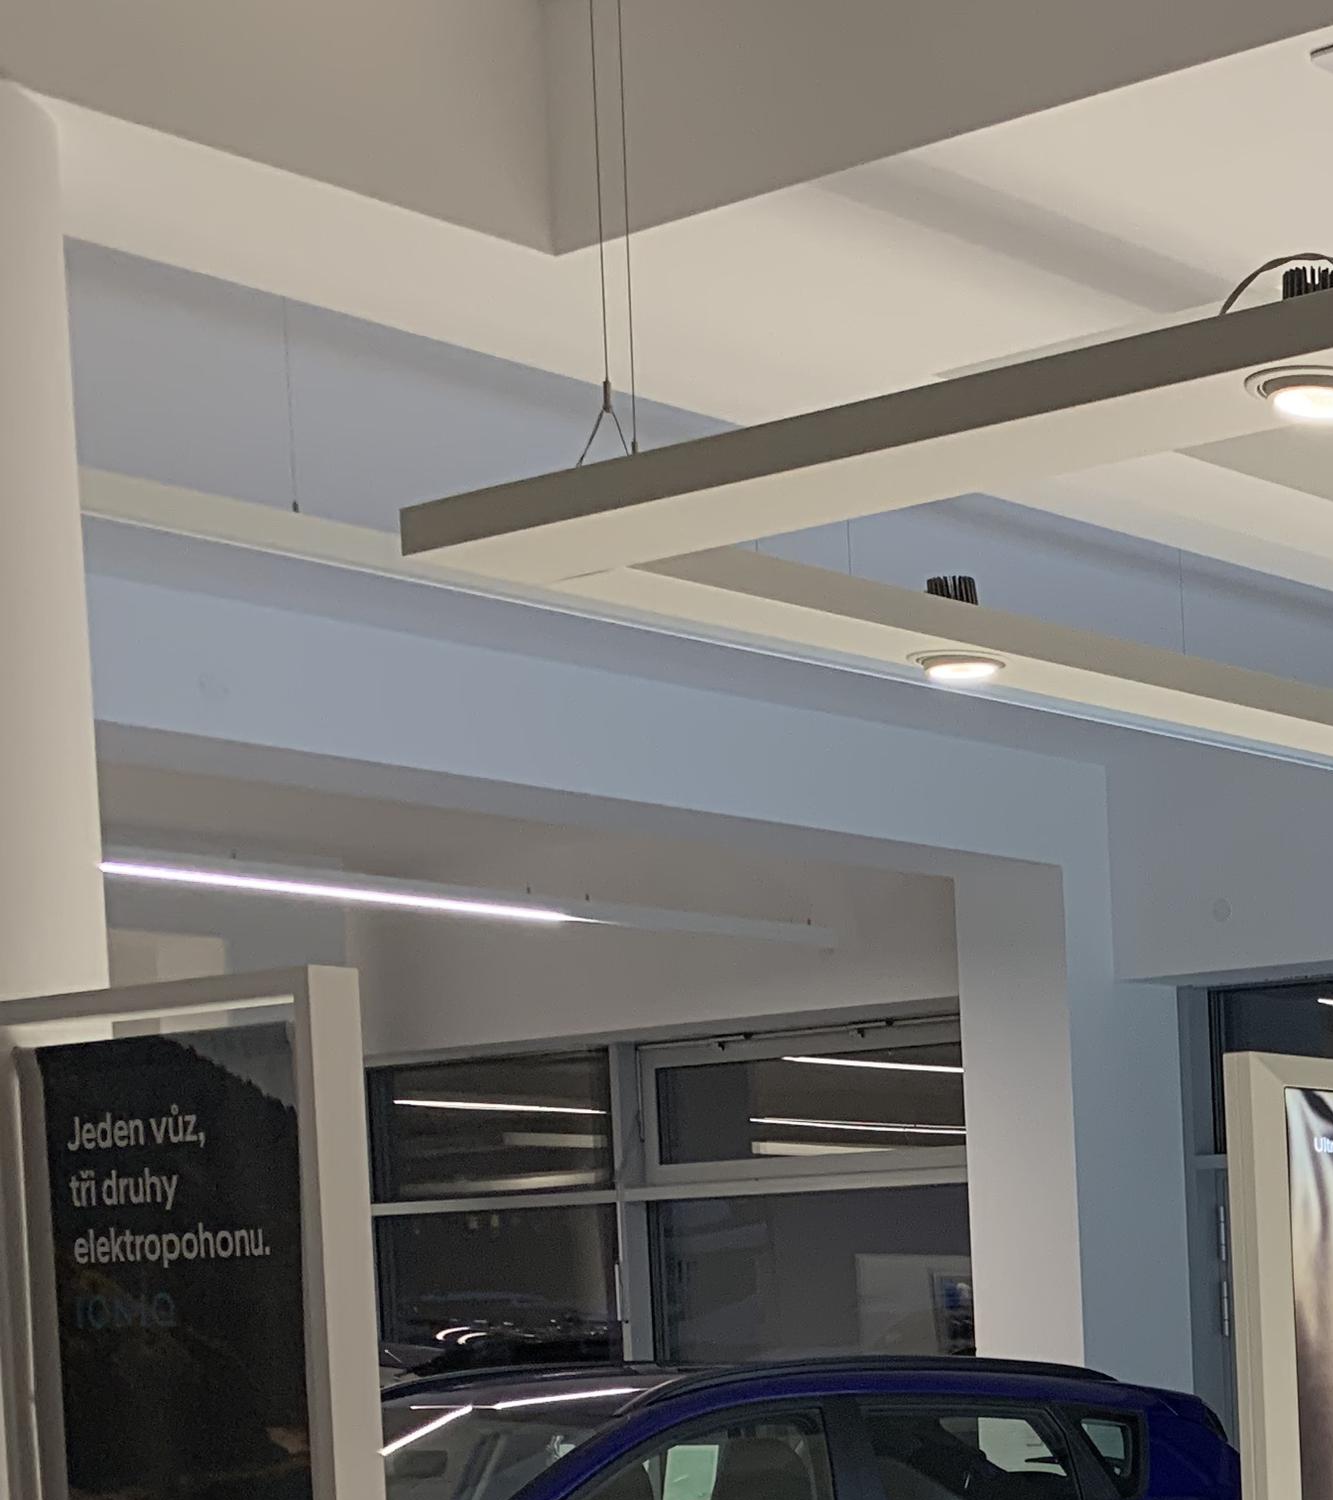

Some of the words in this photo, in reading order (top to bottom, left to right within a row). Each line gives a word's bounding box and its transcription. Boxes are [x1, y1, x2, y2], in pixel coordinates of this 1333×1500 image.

[67, 1112, 144, 1151] Jeden
[149, 1104, 207, 1148] vůz,
[69, 1169, 96, 1208] tři
[101, 1166, 179, 1211] druhy
[73, 1221, 272, 1269] elektropohonu.
